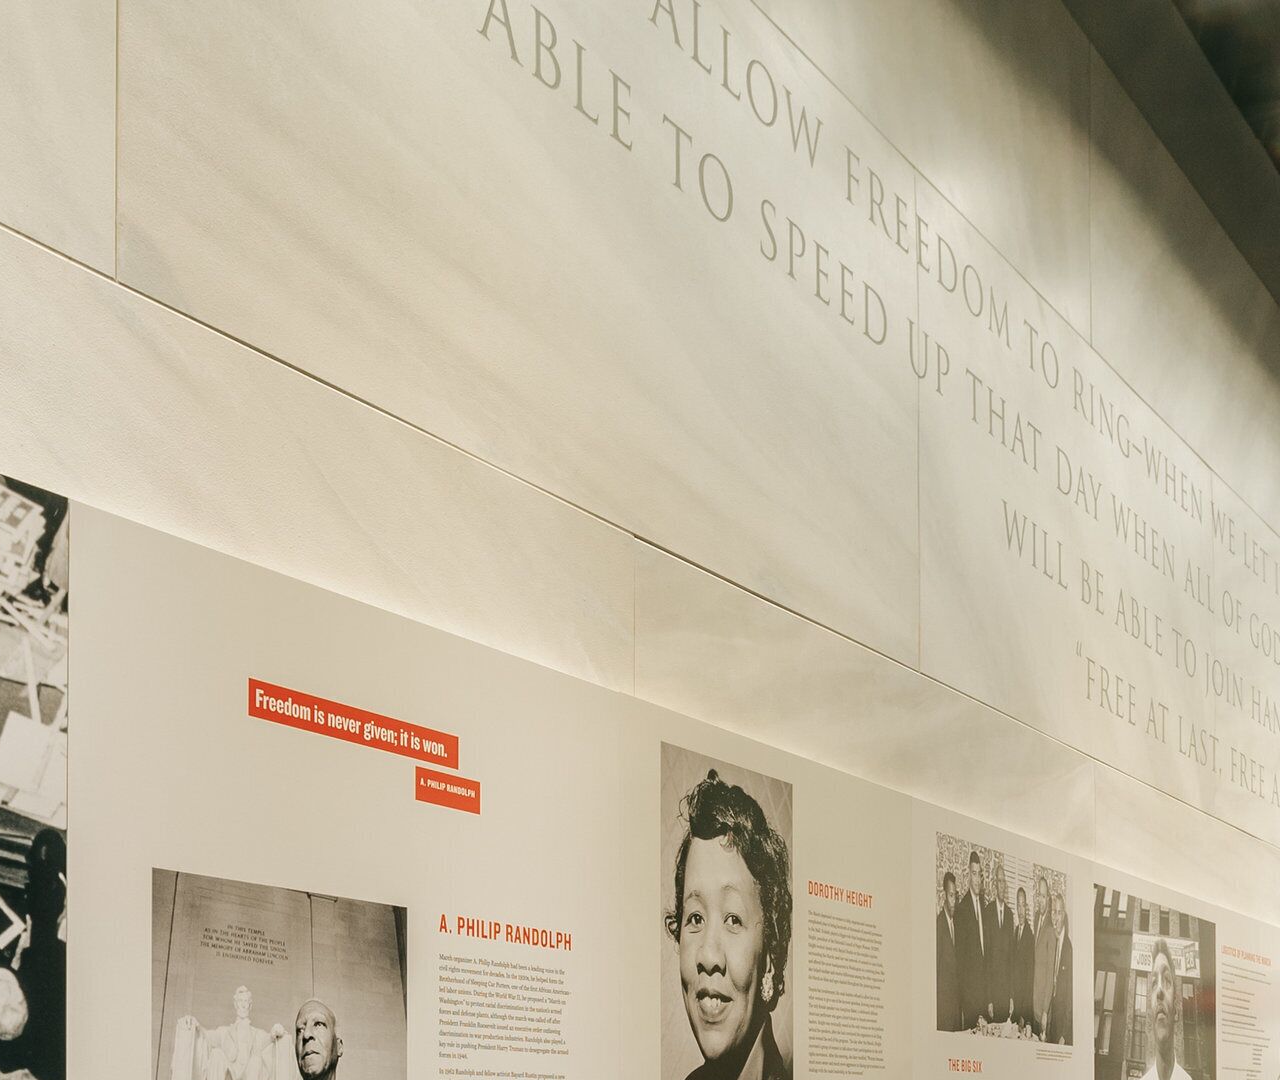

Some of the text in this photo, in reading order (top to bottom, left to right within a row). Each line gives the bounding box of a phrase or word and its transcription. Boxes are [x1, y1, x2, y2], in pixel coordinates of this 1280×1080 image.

[476, 0, 633, 152] ABLE
[662, 113, 733, 223] TO
[760, 199, 887, 346] SPEED
[906, 317, 950, 397] UP
[965, 368, 1042, 473] THAT
[1055, 444, 1102, 522] DAY
[1111, 493, 1175, 582] WHEN
[1184, 558, 1214, 614] ALL
[1222, 590, 1242, 634] OF
[649, 0, 823, 168] ALLOW
[844, 145, 1012, 351] FREEDOM
[1024, 318, 1059, 389] TO
[1211, 500, 1235, 555] WE
[1244, 532, 1268, 583] LET
[1002, 498, 1068, 591] WILL
[1080, 559, 1104, 616] BE
[1115, 587, 1163, 657] ABLE
[1171, 627, 1197, 678] TO
[1205, 651, 1243, 710] JOIN
[255, 688, 448, 758] Freedom is never given; it is won.
[1146, 696, 1169, 745] AT
[1230, 746, 1265, 799] FREE
[427, 779, 446, 791] PHILIP
[446, 784, 476, 798] RANDOLPH
[808, 881, 872, 908] DOROTHY HEIGHT
[439, 914, 572, 951] A. PHILIP RANDOLPH
[948, 1058, 983, 1073] THE BIG SIX
